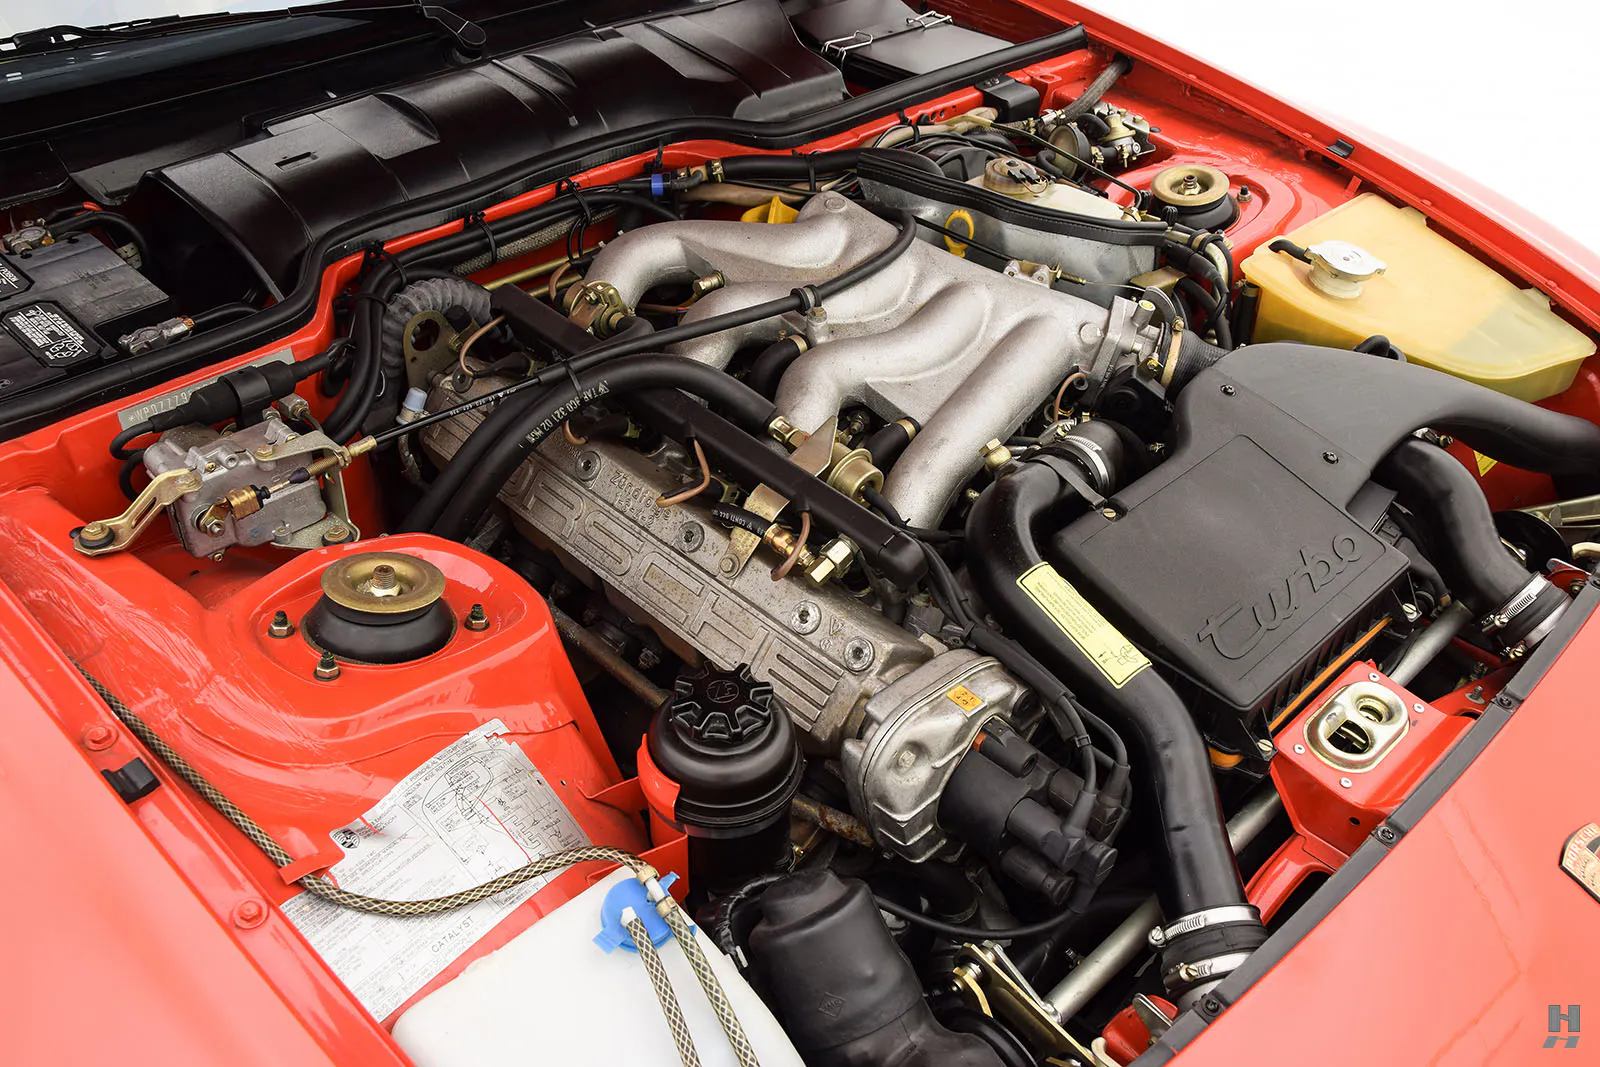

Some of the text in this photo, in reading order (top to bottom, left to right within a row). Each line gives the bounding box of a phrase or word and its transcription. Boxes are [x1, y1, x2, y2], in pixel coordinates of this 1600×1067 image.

[551, 407, 568, 423] 321
[1197, 534, 1363, 660] turbo
[431, 915, 474, 953] CATALYST
